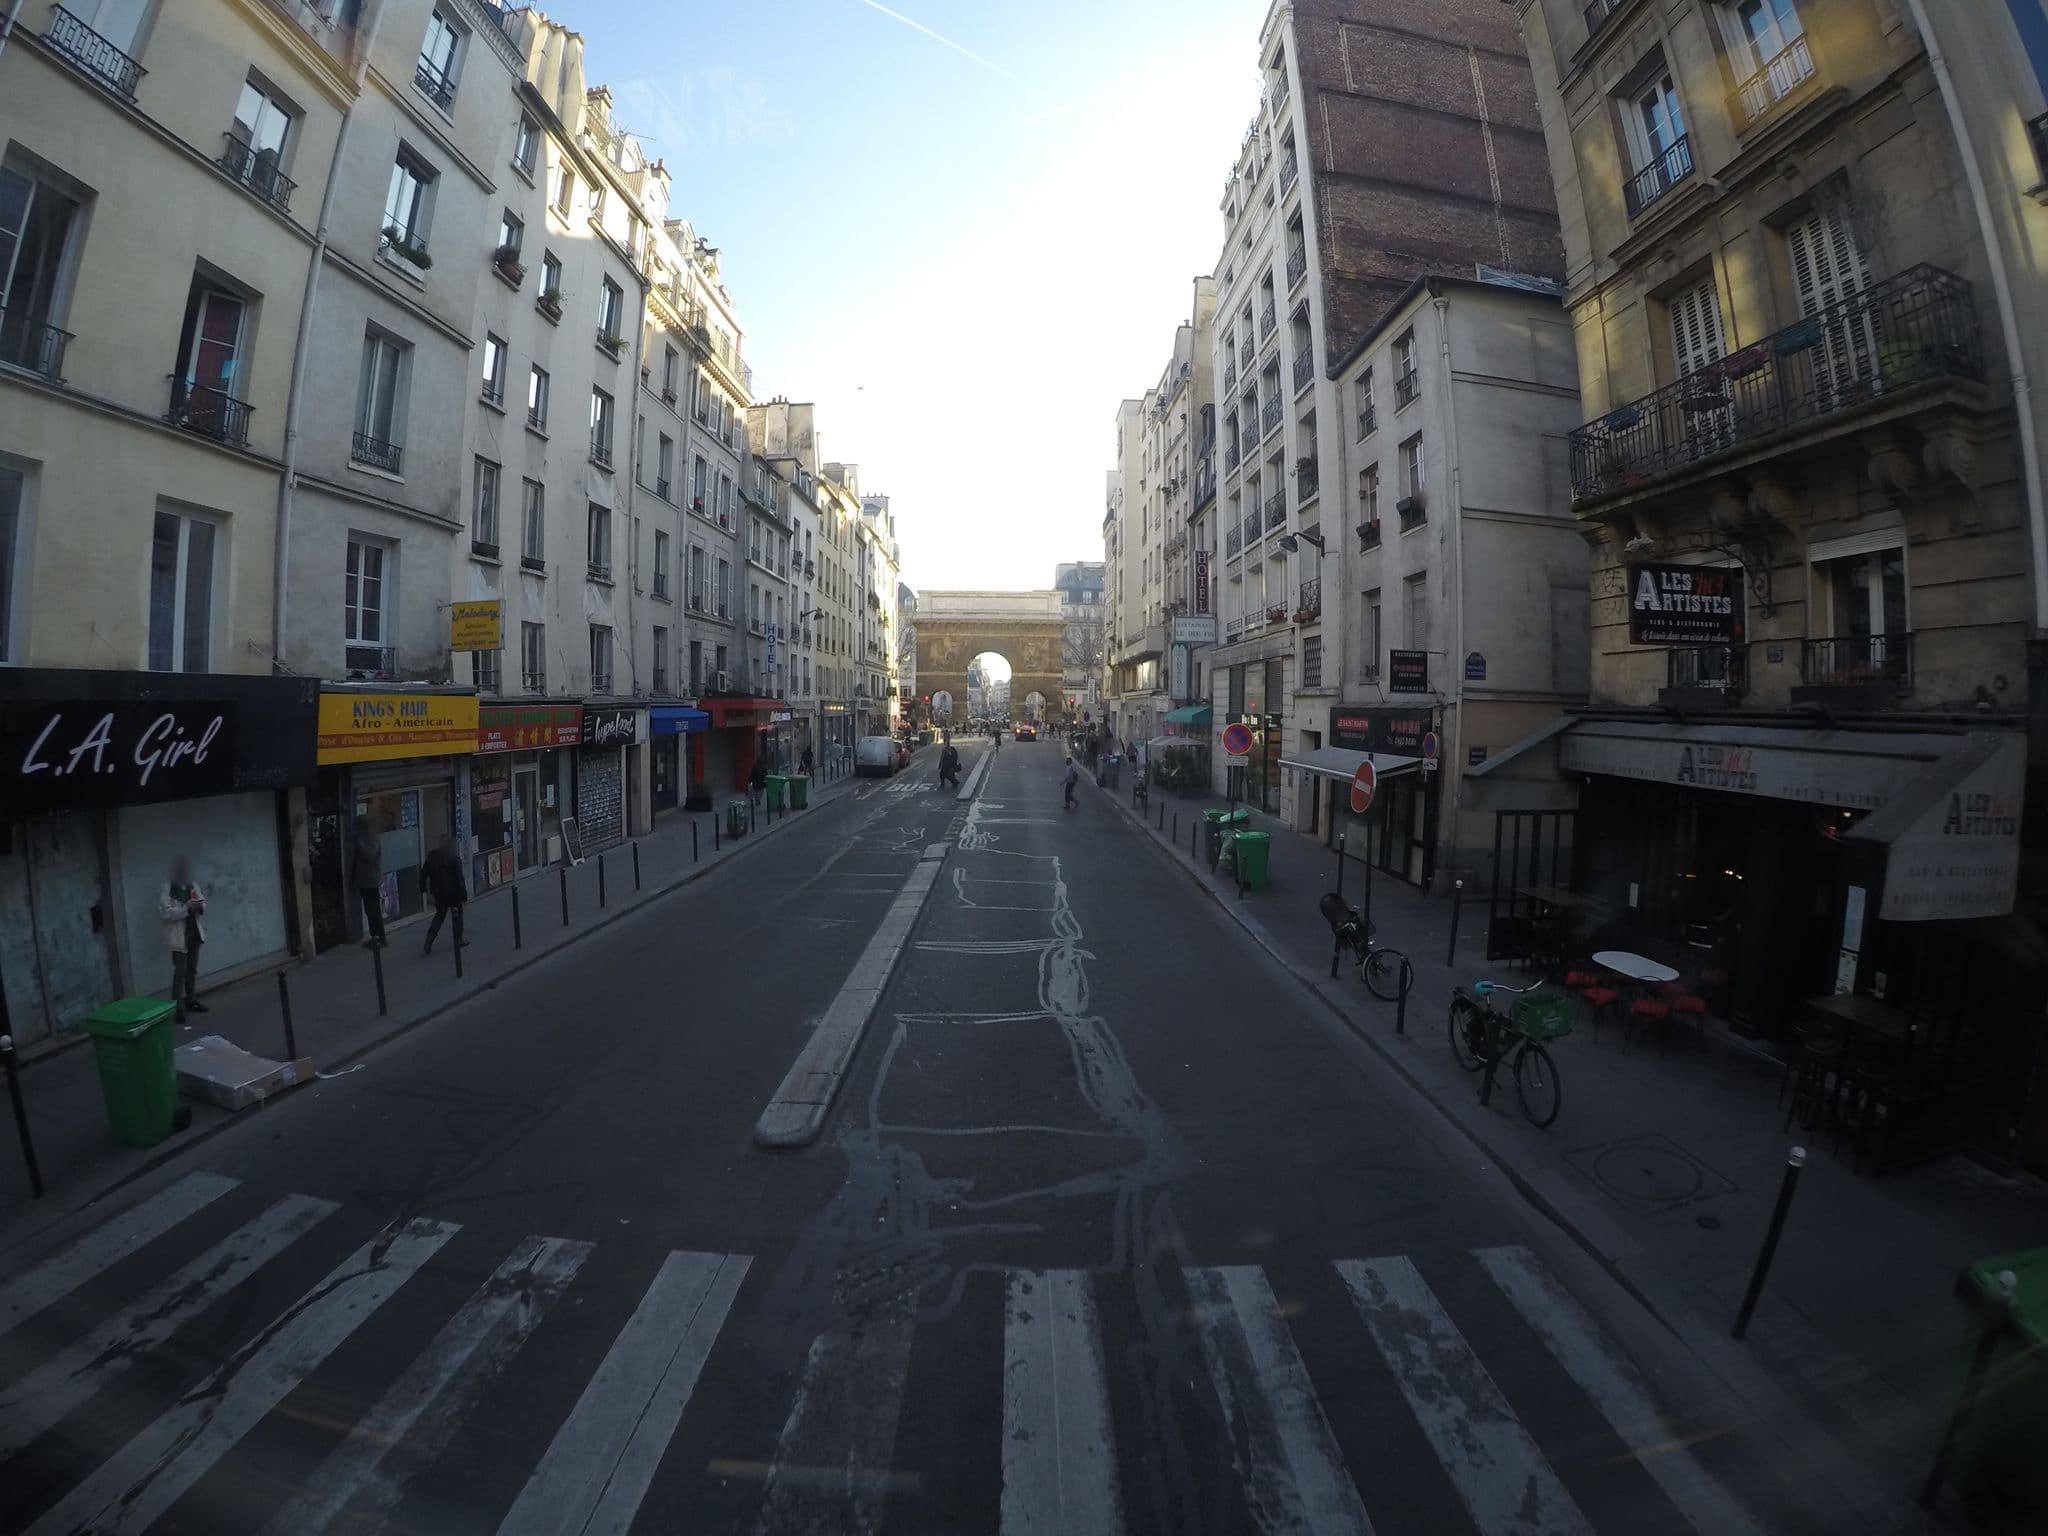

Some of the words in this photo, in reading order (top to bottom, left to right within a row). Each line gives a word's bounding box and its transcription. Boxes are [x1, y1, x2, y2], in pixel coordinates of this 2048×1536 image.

[1197, 553, 1208, 612] HOTEL
[1634, 570, 1732, 614] ARTISTES
[1661, 571, 1692, 591] LES
[767, 625, 776, 673] HOTEL
[352, 718, 383, 729] Afro
[353, 700, 394, 718] KING'S
[400, 700, 428, 717] HAIR
[22, 713, 115, 777] L.A.
[134, 713, 224, 787] Girl
[885, 783, 935, 792] BUS
